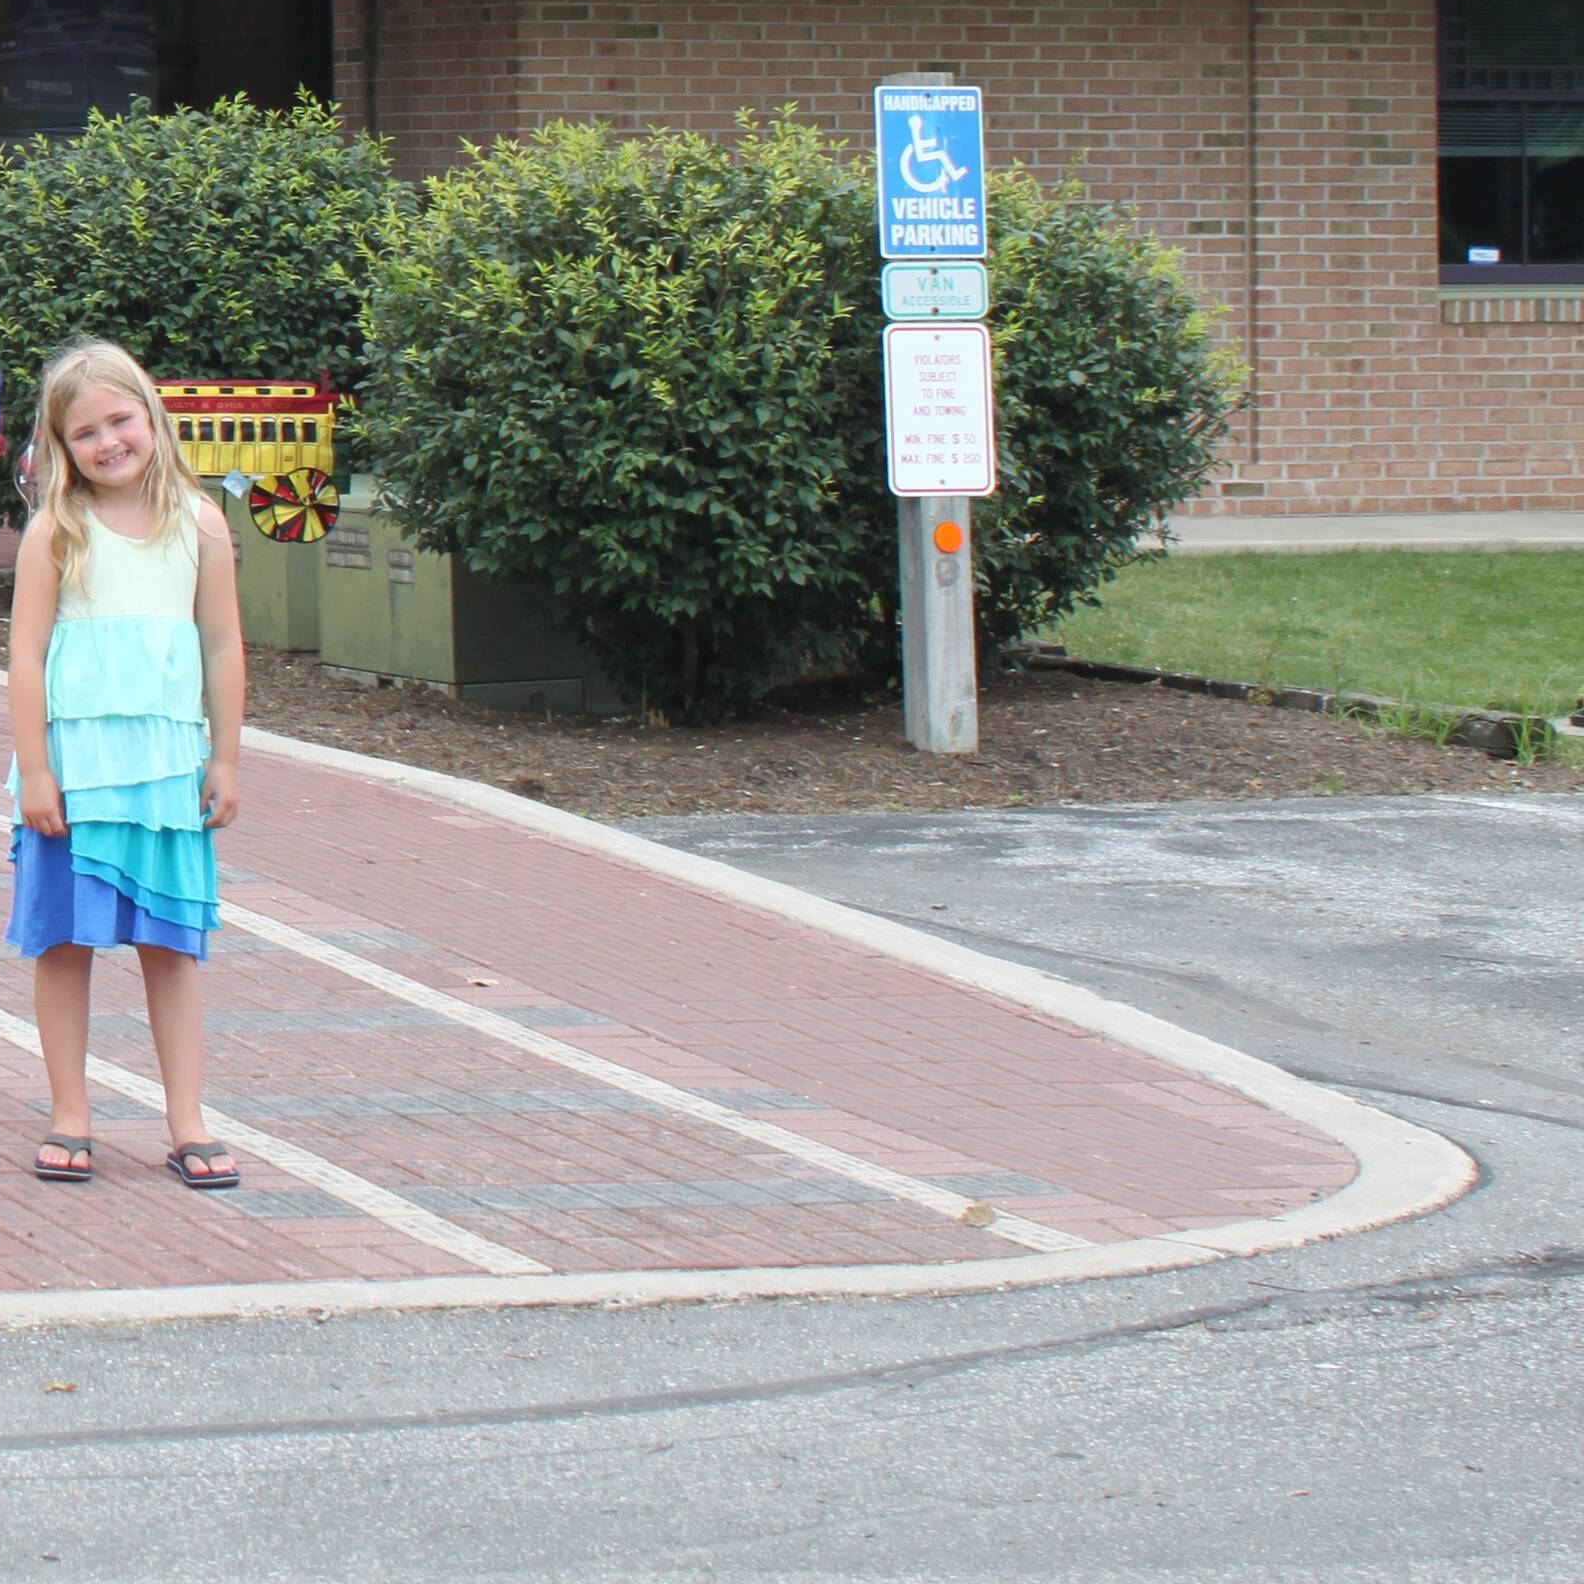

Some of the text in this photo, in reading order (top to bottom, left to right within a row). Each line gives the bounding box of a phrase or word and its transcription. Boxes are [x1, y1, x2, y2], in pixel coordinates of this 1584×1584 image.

[883, 95, 977, 112] HANDICAPPED
[891, 198, 976, 220] VEHICLE
[891, 224, 979, 247] PARKING
[916, 276, 954, 291] VAN
[901, 296, 971, 306] ACCESSIBLE
[913, 354, 962, 365] VIOLATORS
[919, 371, 957, 382] SUBJECT
[922, 388, 956, 399] TO FINE
[912, 406, 967, 416] AND TOWING
[927, 434, 947, 444] FINE
[926, 453, 946, 464] FINE
